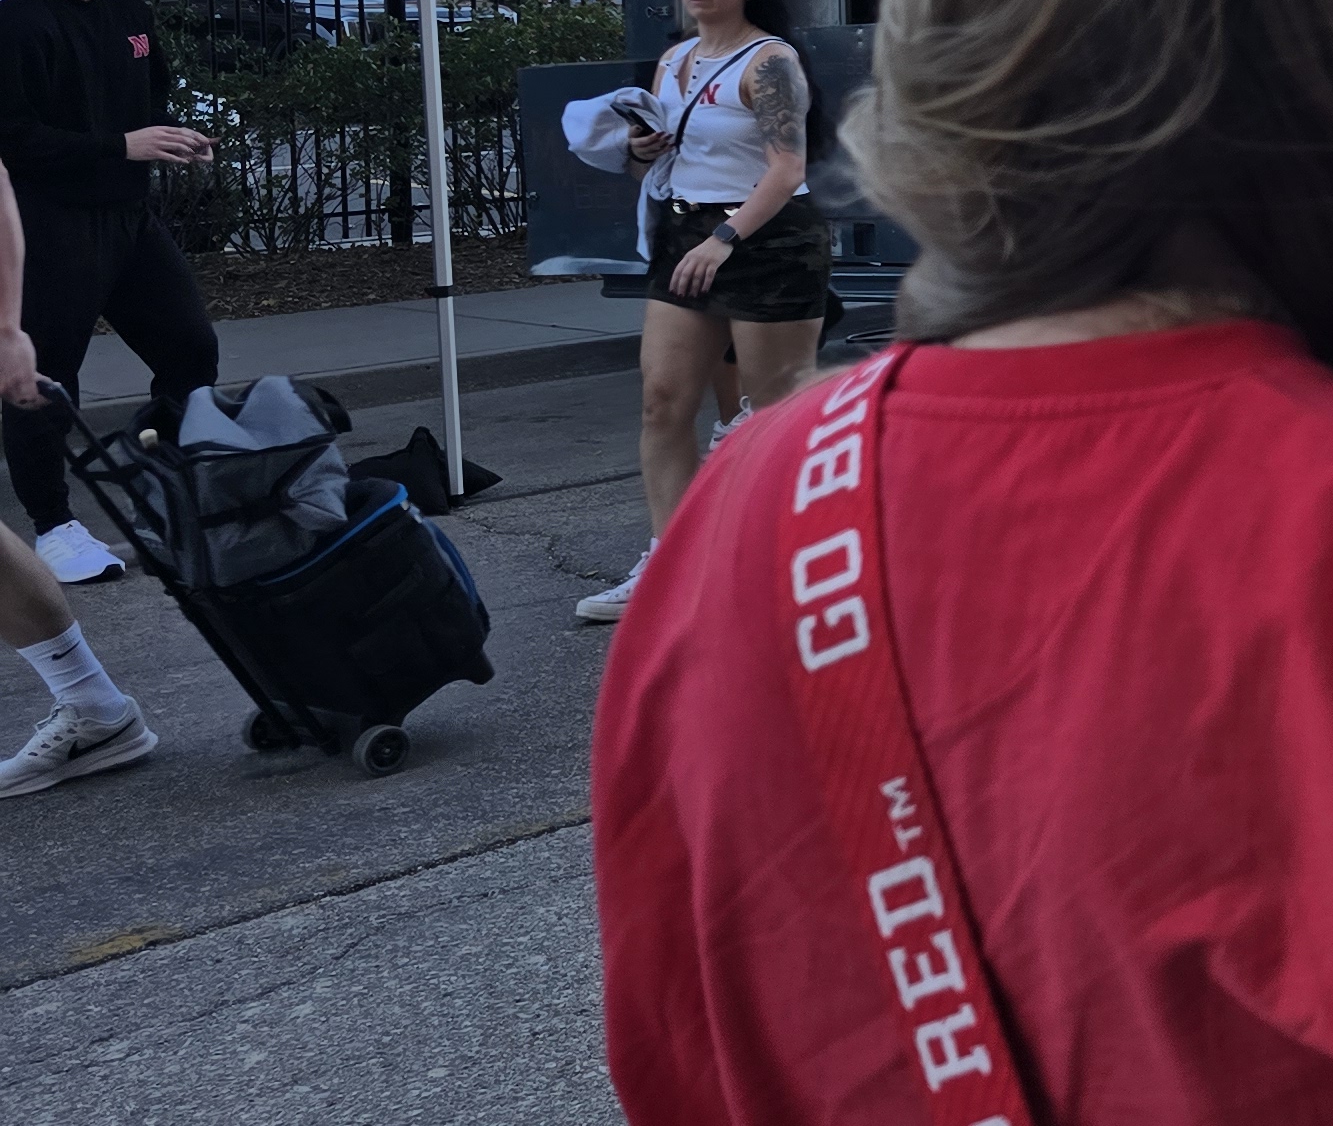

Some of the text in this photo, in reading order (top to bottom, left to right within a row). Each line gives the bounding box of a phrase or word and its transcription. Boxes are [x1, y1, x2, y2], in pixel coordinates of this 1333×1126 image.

[127, 33, 150, 59] N
[699, 83, 722, 105] N
[791, 352, 896, 672] GO BIG
